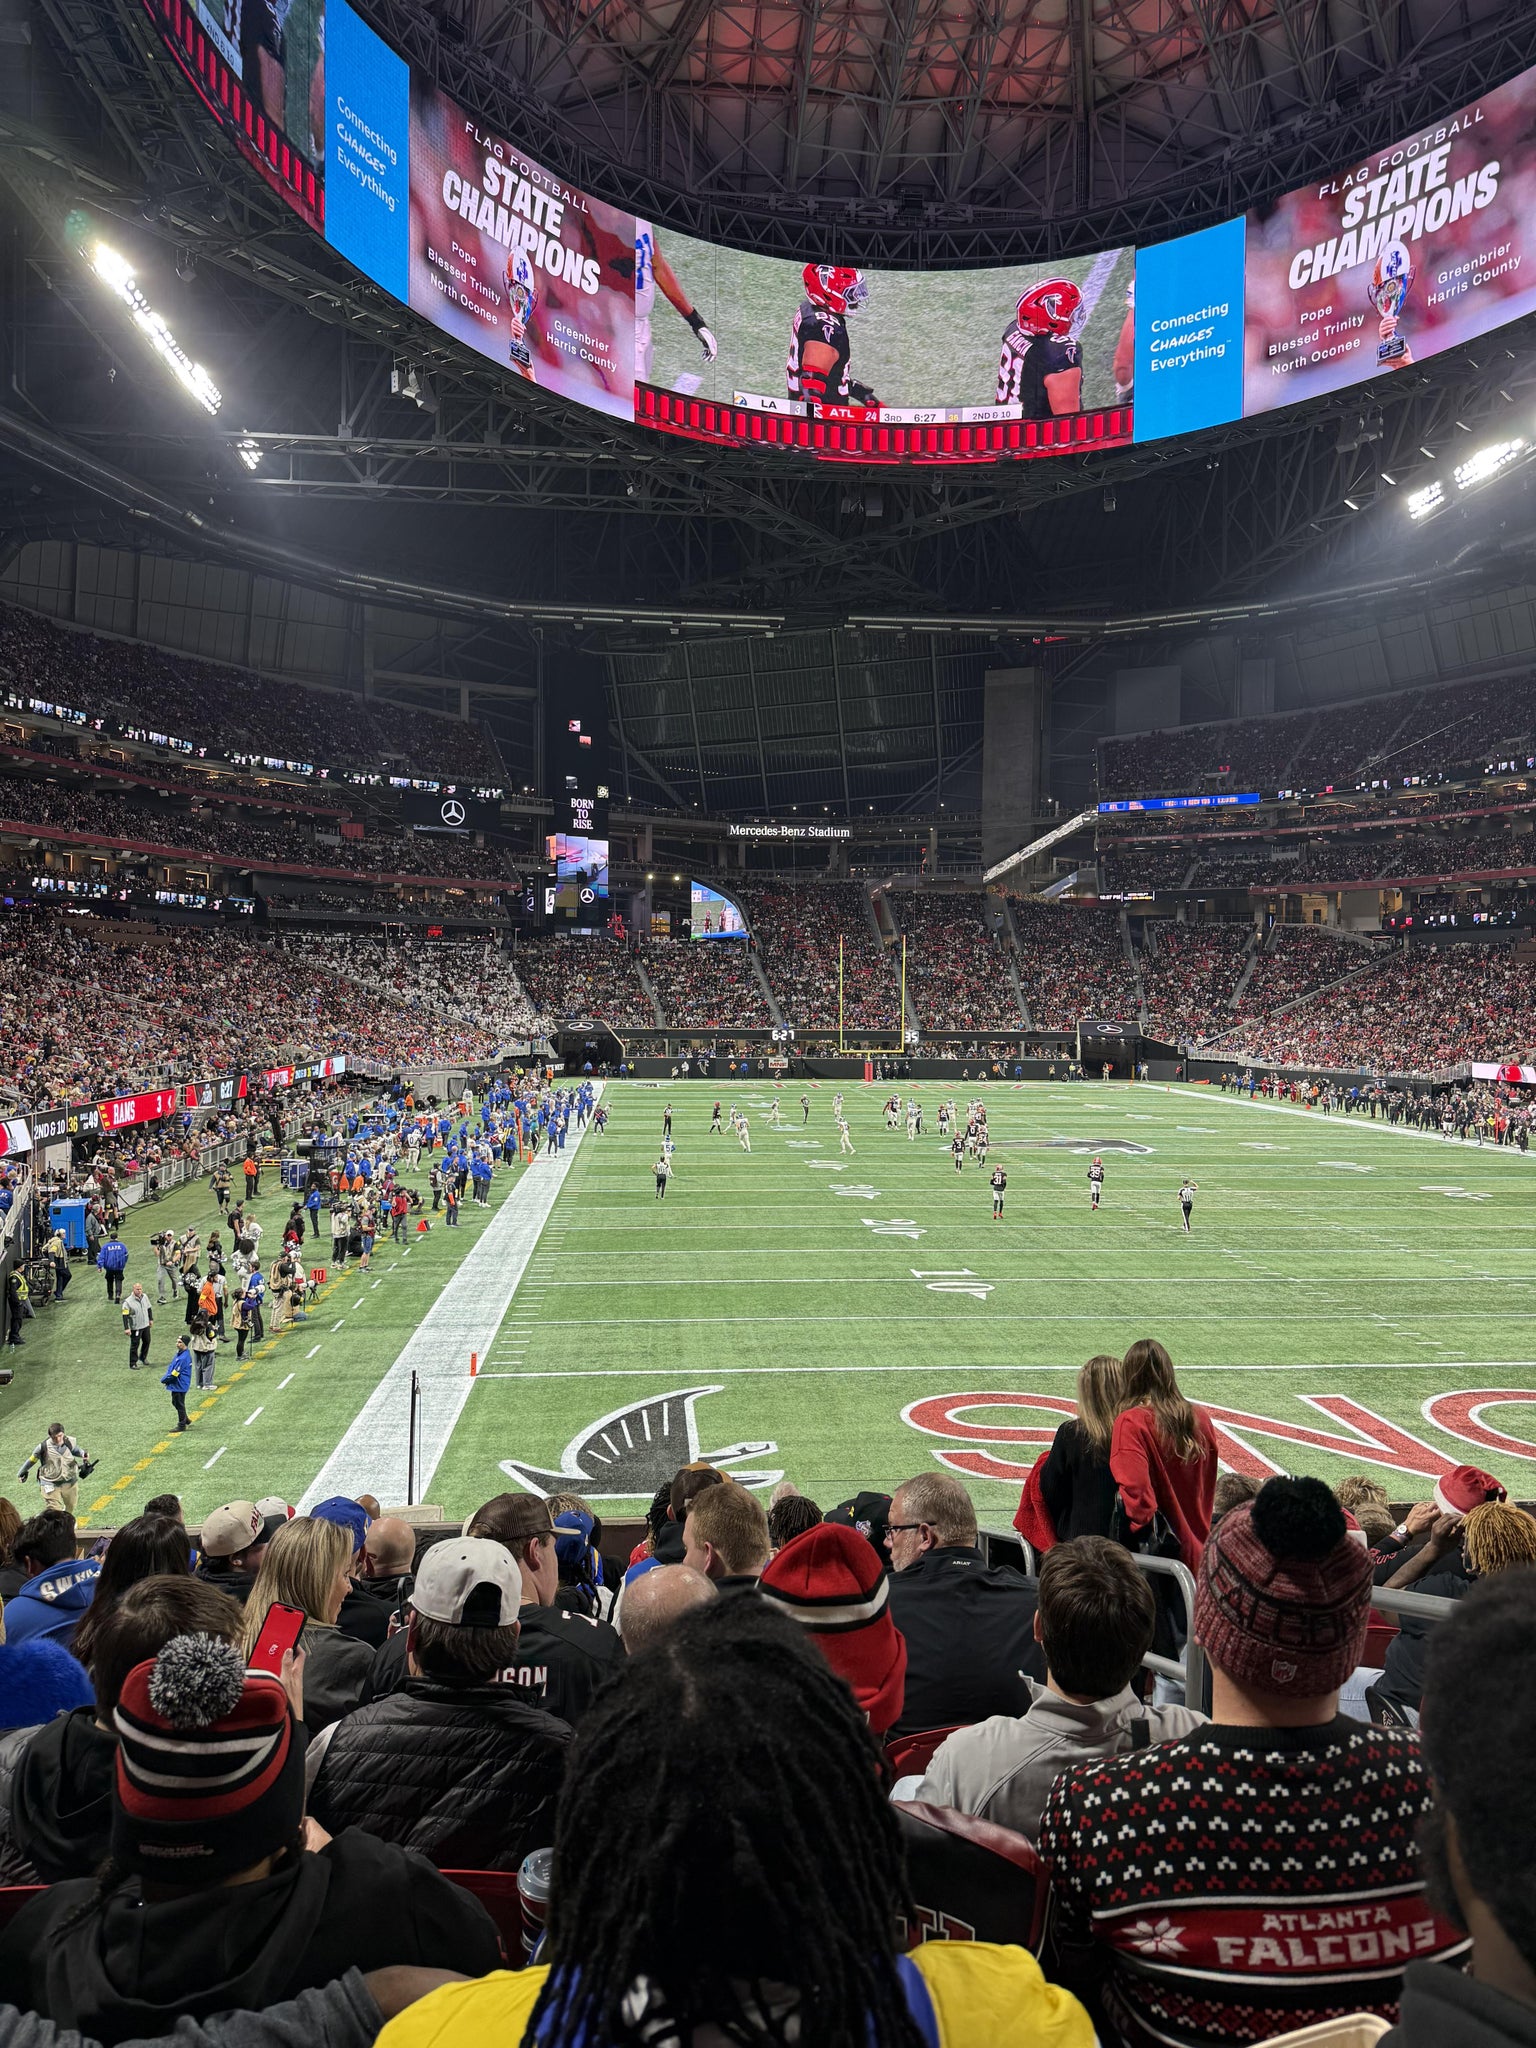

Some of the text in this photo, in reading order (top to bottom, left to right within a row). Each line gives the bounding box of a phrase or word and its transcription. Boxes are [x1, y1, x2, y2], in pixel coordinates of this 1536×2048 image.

[337, 96, 397, 166] Connecting
[336, 123, 387, 176] CHANGES
[1318, 107, 1485, 200] FLAG FOOTBALL
[337, 146, 396, 212] Everything
[465, 121, 590, 214] FLAG FOOTBALL
[483, 156, 565, 238] STATE
[1341, 141, 1452, 230] STATE
[442, 170, 601, 295] CHAMPIONS
[1288, 160, 1500, 290] CHAMPIONS
[451, 241, 477, 267] Pope
[1437, 241, 1512, 285] Greenbrier
[427, 247, 501, 306] Blessed Trinity
[1427, 255, 1522, 307] Harris County
[429, 272, 498, 325] North Oconee
[1151, 302, 1229, 332] Connecting
[1300, 304, 1333, 325] Pope
[554, 320, 609, 353] Greenbrier
[1006, 330, 1034, 357] GARCIA
[1150, 326, 1215, 352] CHANGES
[1268, 313, 1365, 357] Blessed Trinity
[546, 331, 617, 372] Harris County
[1151, 344, 1226, 372] Everything
[1271, 336, 1361, 375] North Oconee
[761, 399, 801, 415] LA 3
[829, 407, 877, 422] ATL 24
[884, 413, 902, 422] 3RD
[914, 413, 937, 423] 6:27
[972, 412, 991, 421] 2ND
[992, 411, 999, 420] &
[1001, 410, 1011, 419] 10
[570, 797, 595, 809] BORN
[576, 808, 589, 819] TO
[729, 825, 850, 838] Mercedes-Benz Stadium
[771, 1029, 795, 1041] 6:27
[904, 1031, 919, 1043] 35
[220, 1080, 233, 1099] 6:27
[89, 1110, 98, 1128] 49
[113, 1095, 162, 1125] RAMS 3
[33, 1122, 49, 1140] 2ND
[50, 1121, 56, 1136] &
[56, 1119, 66, 1135] 10
[993, 1175, 1002, 1185] 31
[860, 1218, 928, 1235] 20
[313, 1269, 324, 1281] 10
[909, 1268, 996, 1293] 10
[1262, 1906, 1392, 1932] ATLANTA
[1213, 1919, 1436, 1968] FALCONS
